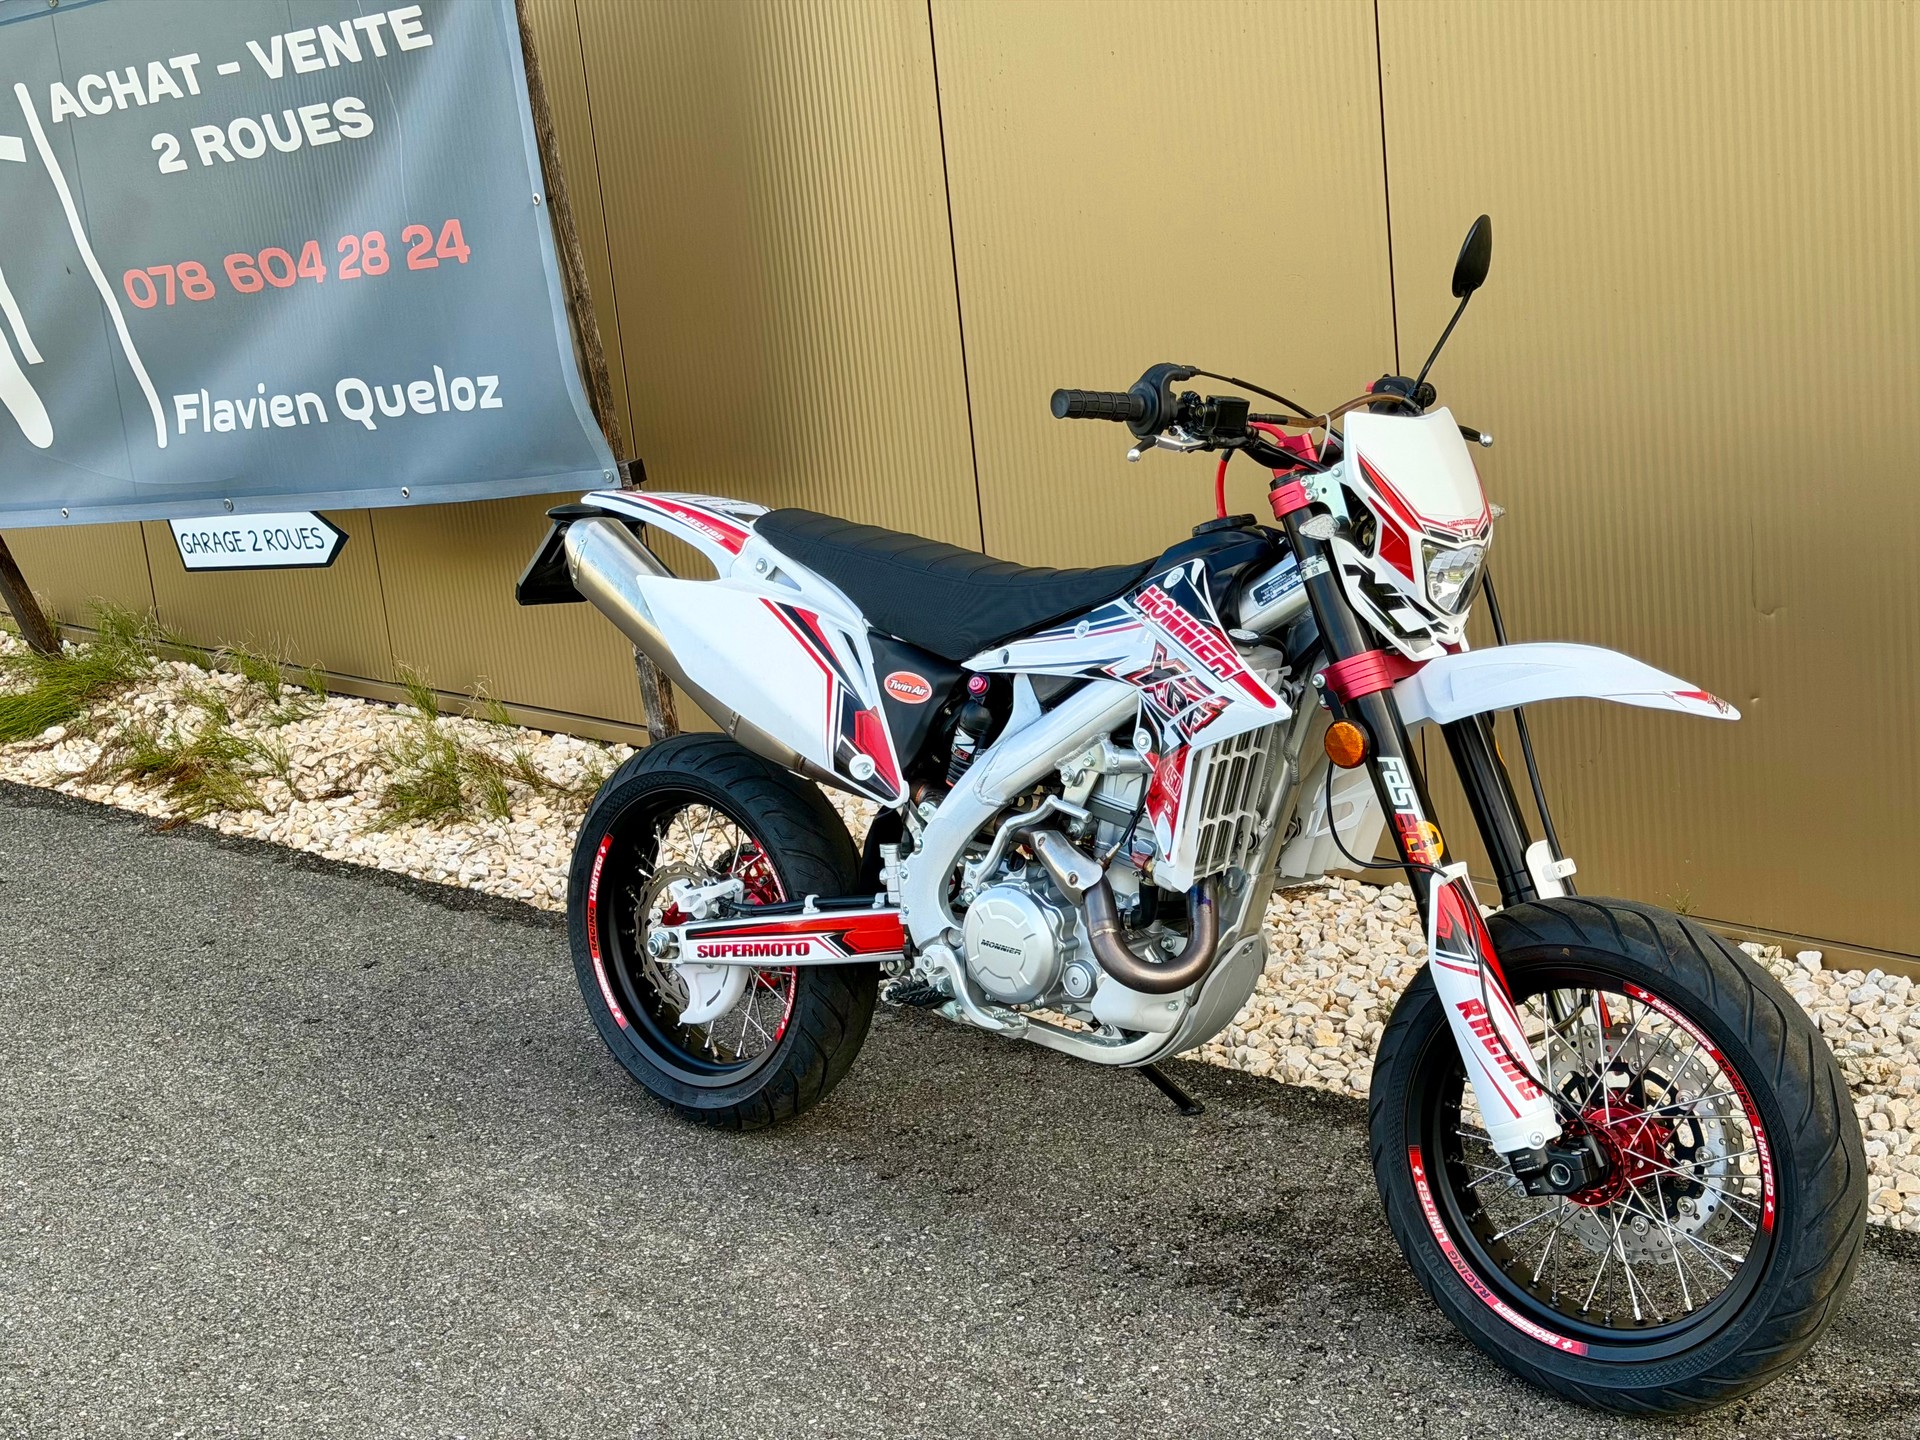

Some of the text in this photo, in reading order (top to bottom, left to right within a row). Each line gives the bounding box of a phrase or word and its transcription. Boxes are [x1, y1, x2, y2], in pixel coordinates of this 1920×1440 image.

[50, 5, 433, 123] ACHAT - VENTE
[151, 97, 375, 174] 2 ROUES
[123, 219, 471, 309] 078 604 28 24
[173, 365, 503, 434] Flavien Queloz
[180, 527, 325, 554] GARAGE 2 ROUES
[1133, 584, 1243, 682] MONNIER
[890, 679, 927, 696] Twin Air
[590, 855, 603, 902] LIMITED
[590, 907, 599, 951] RACING
[697, 942, 810, 958] SUPERMOTO
[981, 939, 1022, 955] MONNIER
[1456, 998, 1543, 1101] RACING
[1651, 998, 1774, 1197] MONNIER RACING LIMITED
[1417, 1181, 1560, 1345] MONNIER RACING LIMITED
